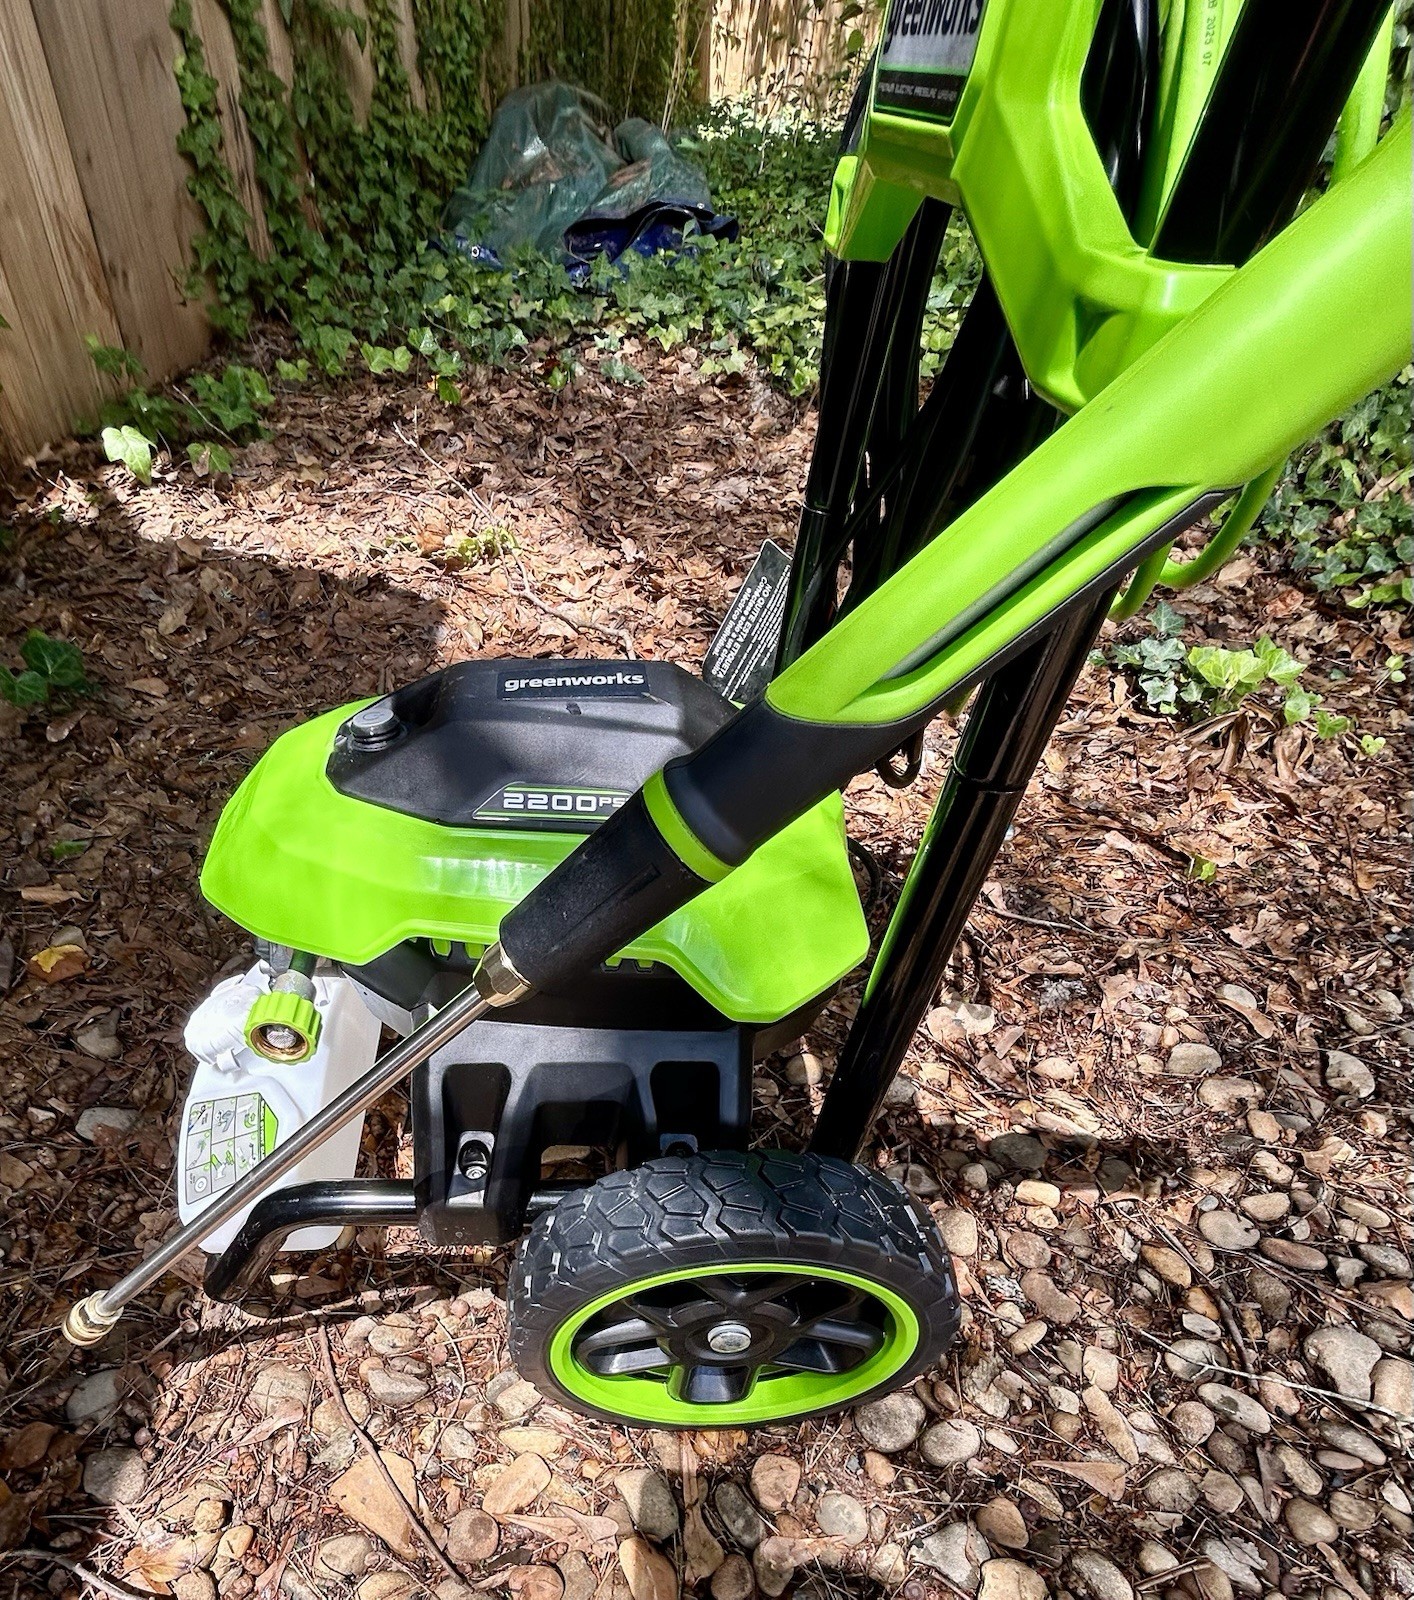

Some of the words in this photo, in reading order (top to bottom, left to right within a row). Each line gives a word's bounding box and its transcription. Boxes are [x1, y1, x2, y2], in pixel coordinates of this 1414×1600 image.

[1204, 16, 1217, 45] 2025
[1202, 51, 1213, 66] 07
[761, 583, 772, 598] NO
[748, 596, 766, 623] QUITE
[734, 615, 747, 633] solo
[736, 621, 752, 643] ESTA
[725, 638, 734, 649] un
[711, 648, 729, 675] circuito
[716, 642, 741, 679] ETIQUETA
[504, 672, 645, 692] greenworks
